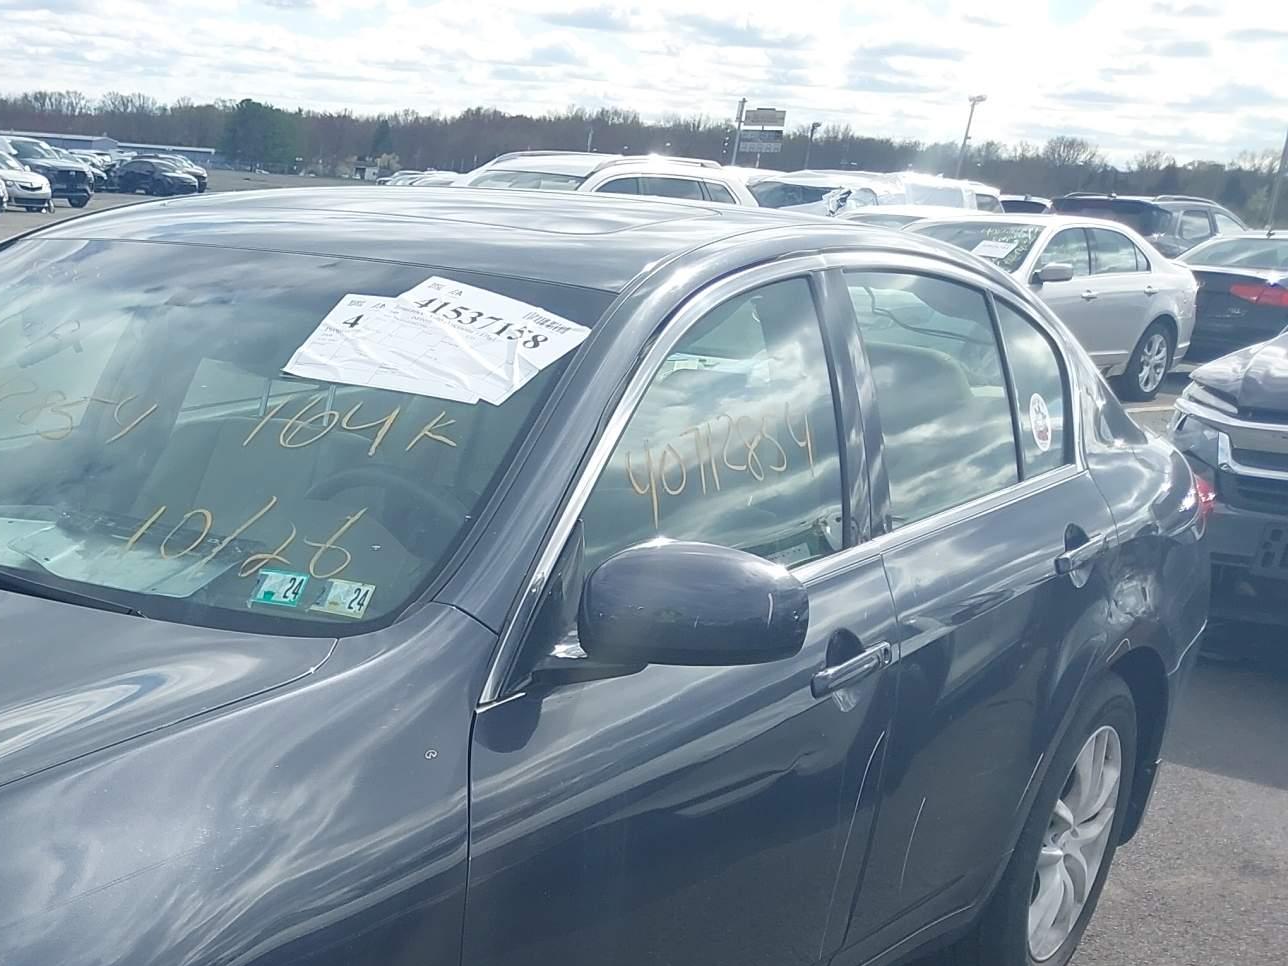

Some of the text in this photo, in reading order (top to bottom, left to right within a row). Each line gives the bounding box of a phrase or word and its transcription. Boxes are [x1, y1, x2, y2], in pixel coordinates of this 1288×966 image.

[413, 297, 548, 349] 41537158
[626, 401, 816, 529] 40712854
[282, 576, 305, 600] 24
[347, 587, 370, 612] 24
